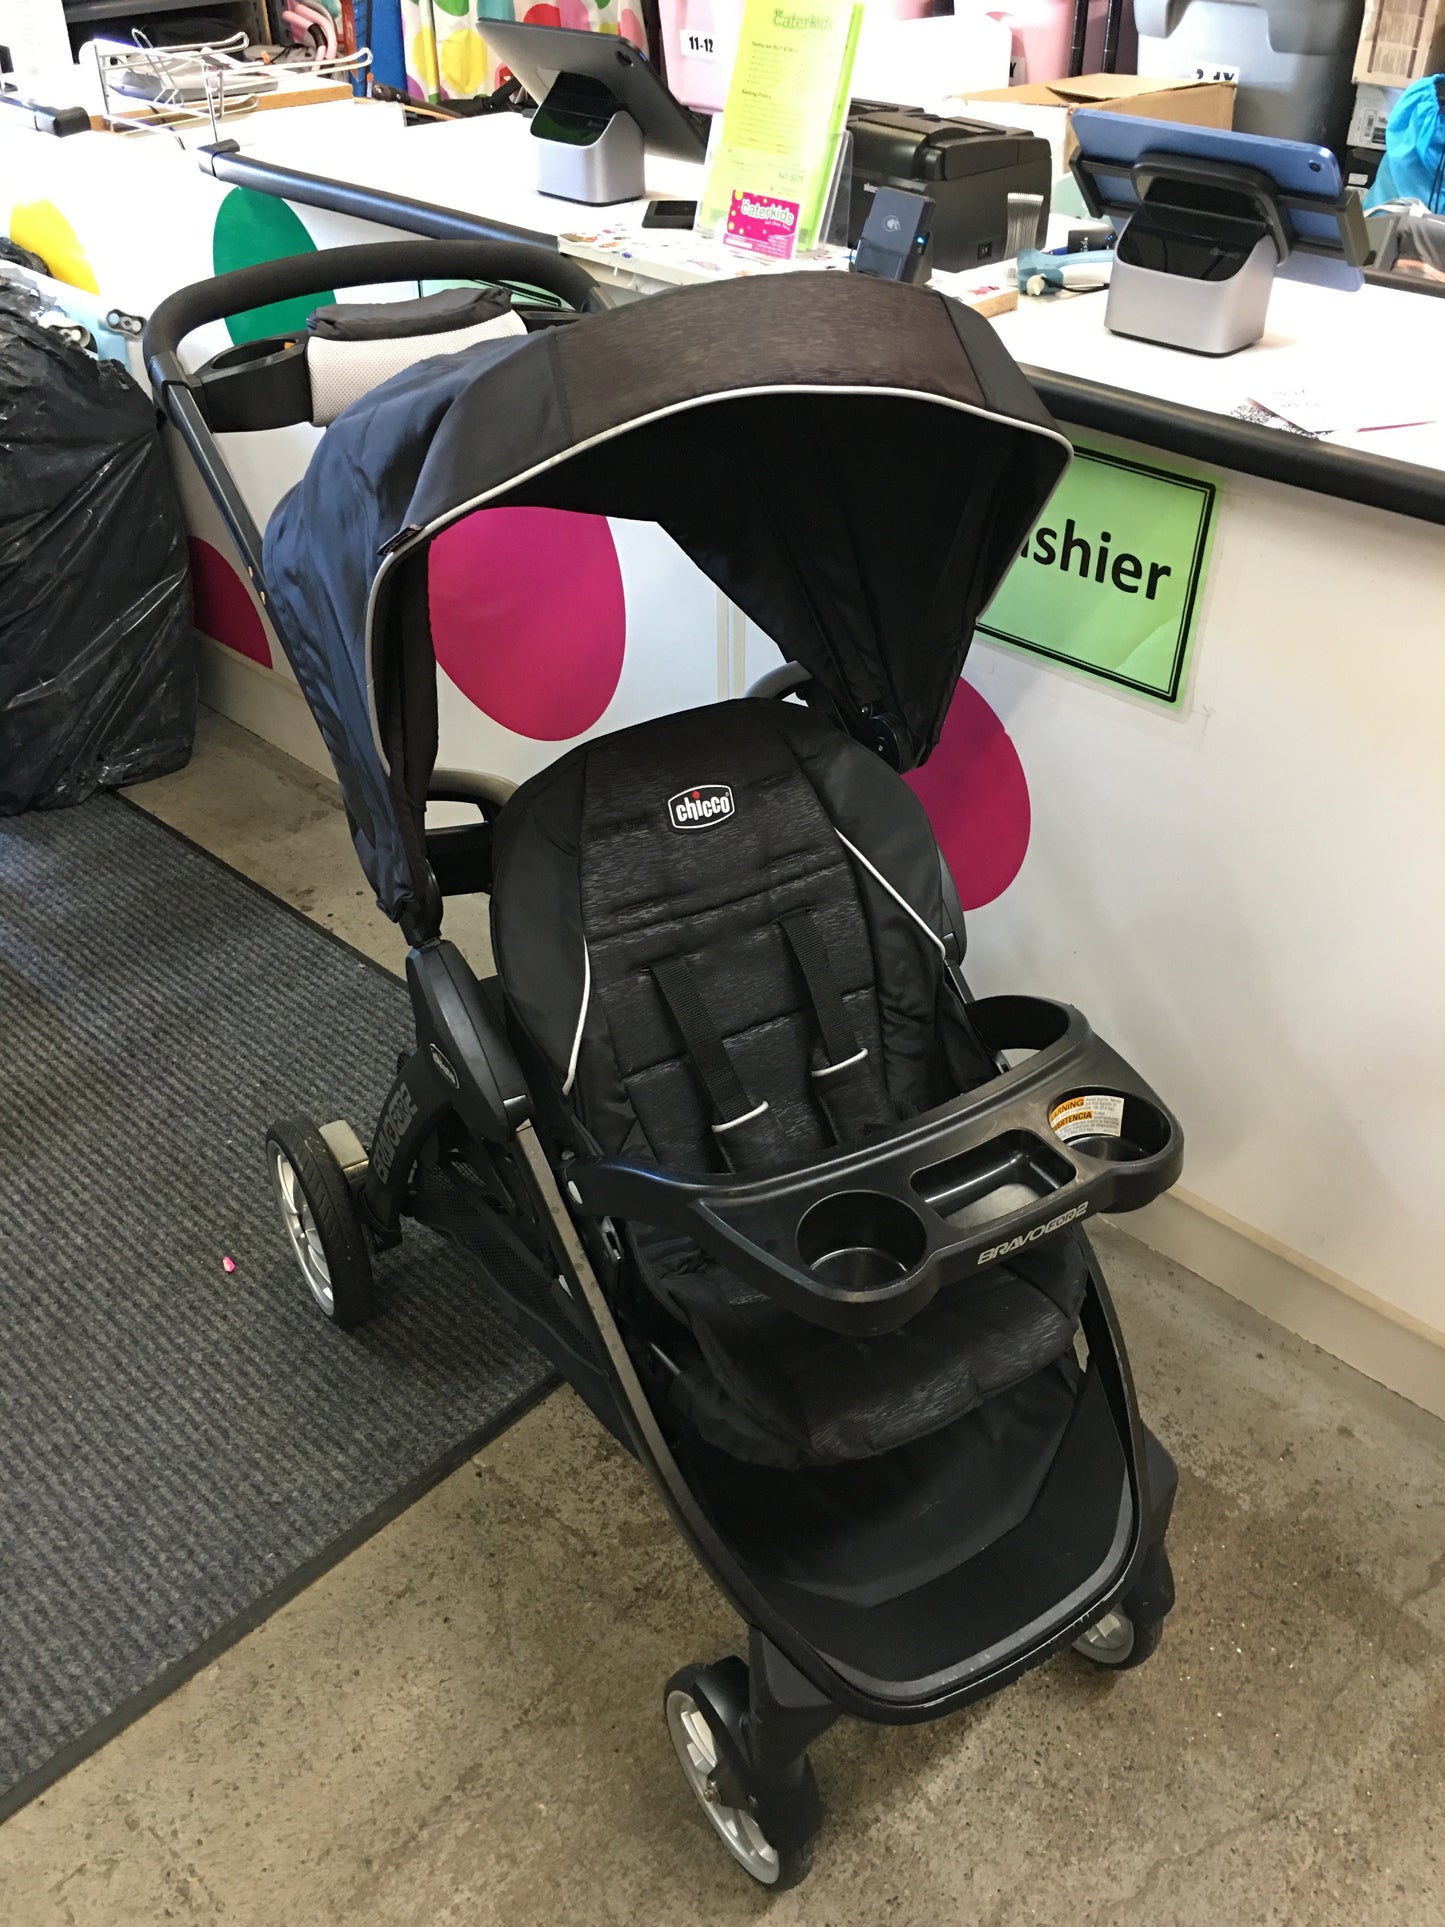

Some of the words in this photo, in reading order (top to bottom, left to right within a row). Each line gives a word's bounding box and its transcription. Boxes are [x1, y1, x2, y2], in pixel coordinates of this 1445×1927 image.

[689, 36, 714, 53] 11-12
[1020, 518, 1171, 601] shier
[675, 790, 730, 822] chicco
